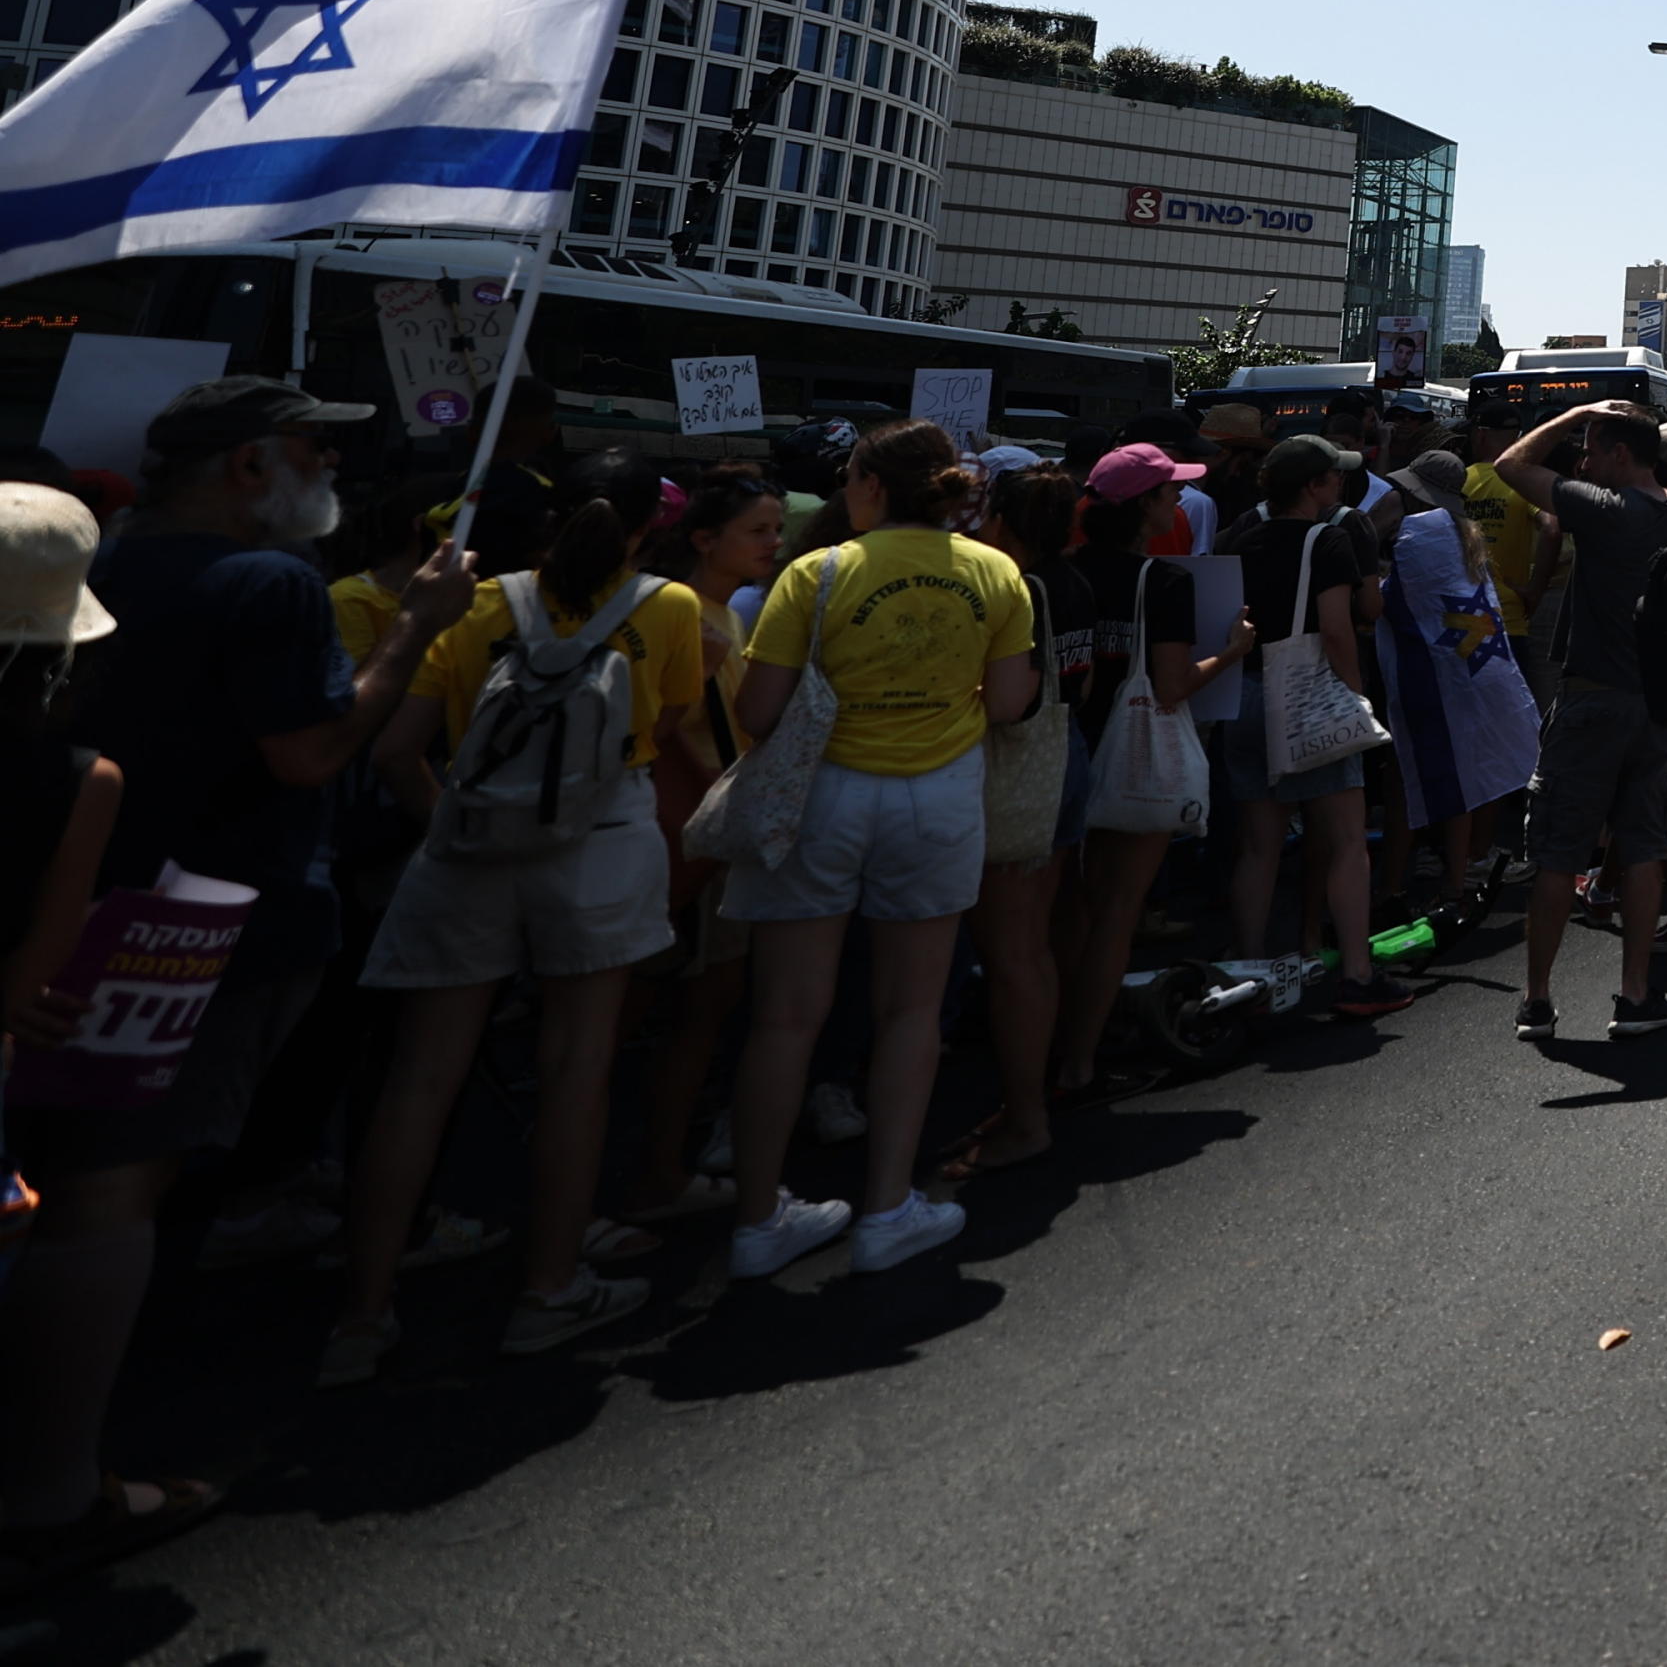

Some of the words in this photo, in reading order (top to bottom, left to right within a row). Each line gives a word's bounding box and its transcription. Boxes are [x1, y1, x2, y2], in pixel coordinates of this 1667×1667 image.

[922, 375, 983, 413] STOP
[924, 408, 977, 429] THE
[851, 577, 911, 627] BETTER
[911, 574, 986, 623] TOGETHER
[1290, 720, 1368, 762] LISBOA
